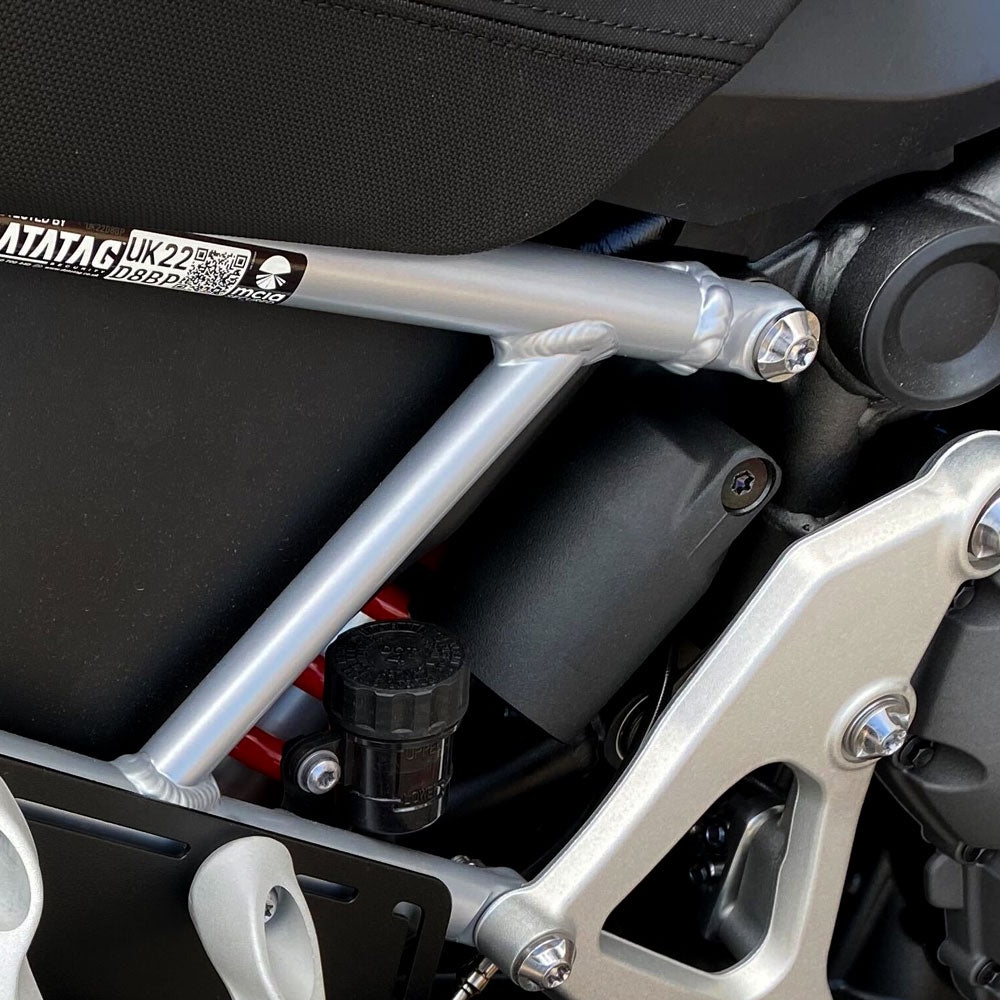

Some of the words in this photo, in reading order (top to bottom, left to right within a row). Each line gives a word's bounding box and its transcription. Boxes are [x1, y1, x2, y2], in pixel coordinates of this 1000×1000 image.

[125, 236, 194, 270] UK22
[110, 265, 181, 287] D8BP
[231, 286, 287, 303] mcia
